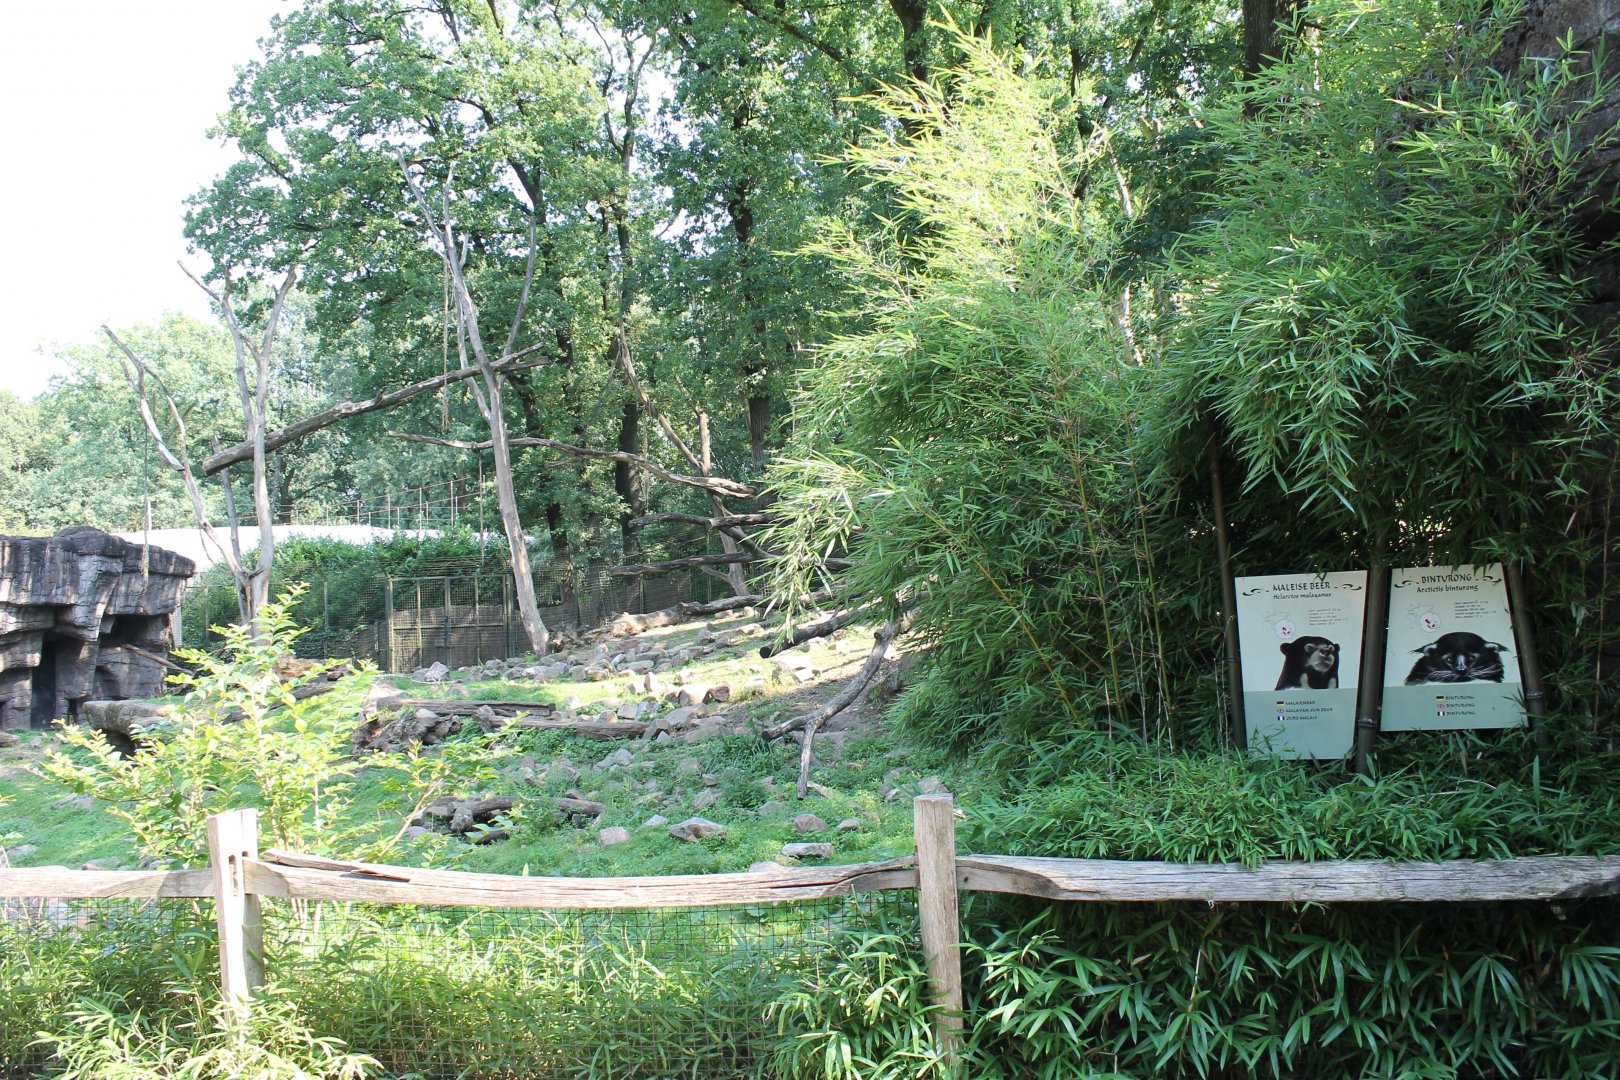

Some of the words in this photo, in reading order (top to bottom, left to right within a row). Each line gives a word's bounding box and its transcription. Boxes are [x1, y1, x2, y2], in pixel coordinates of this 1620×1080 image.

[1421, 573, 1472, 584] BINTURONG
[1272, 582, 1308, 591] MALEISE
[1309, 581, 1331, 590] BEER
[1416, 585, 1444, 593] Arctictis
[1444, 584, 1479, 592] binturong
